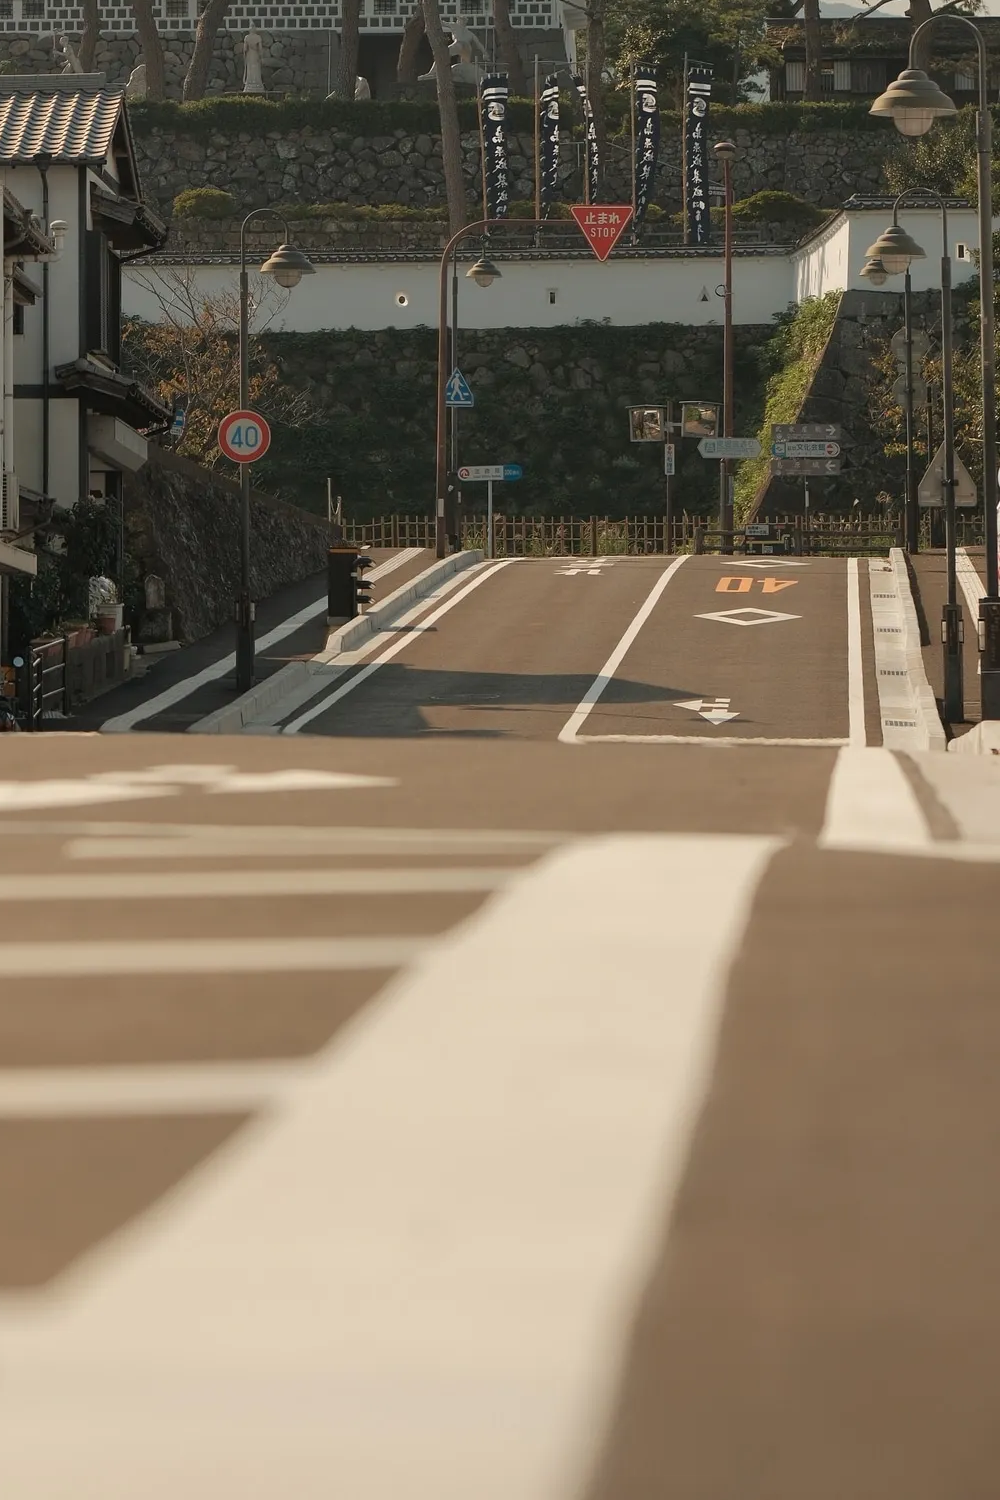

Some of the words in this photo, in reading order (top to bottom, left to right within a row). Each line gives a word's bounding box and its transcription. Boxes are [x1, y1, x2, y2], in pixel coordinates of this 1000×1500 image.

[583, 211, 621, 225] 止まれ
[590, 227, 616, 238] STOP
[230, 425, 260, 448] 40
[715, 576, 799, 593] 40
